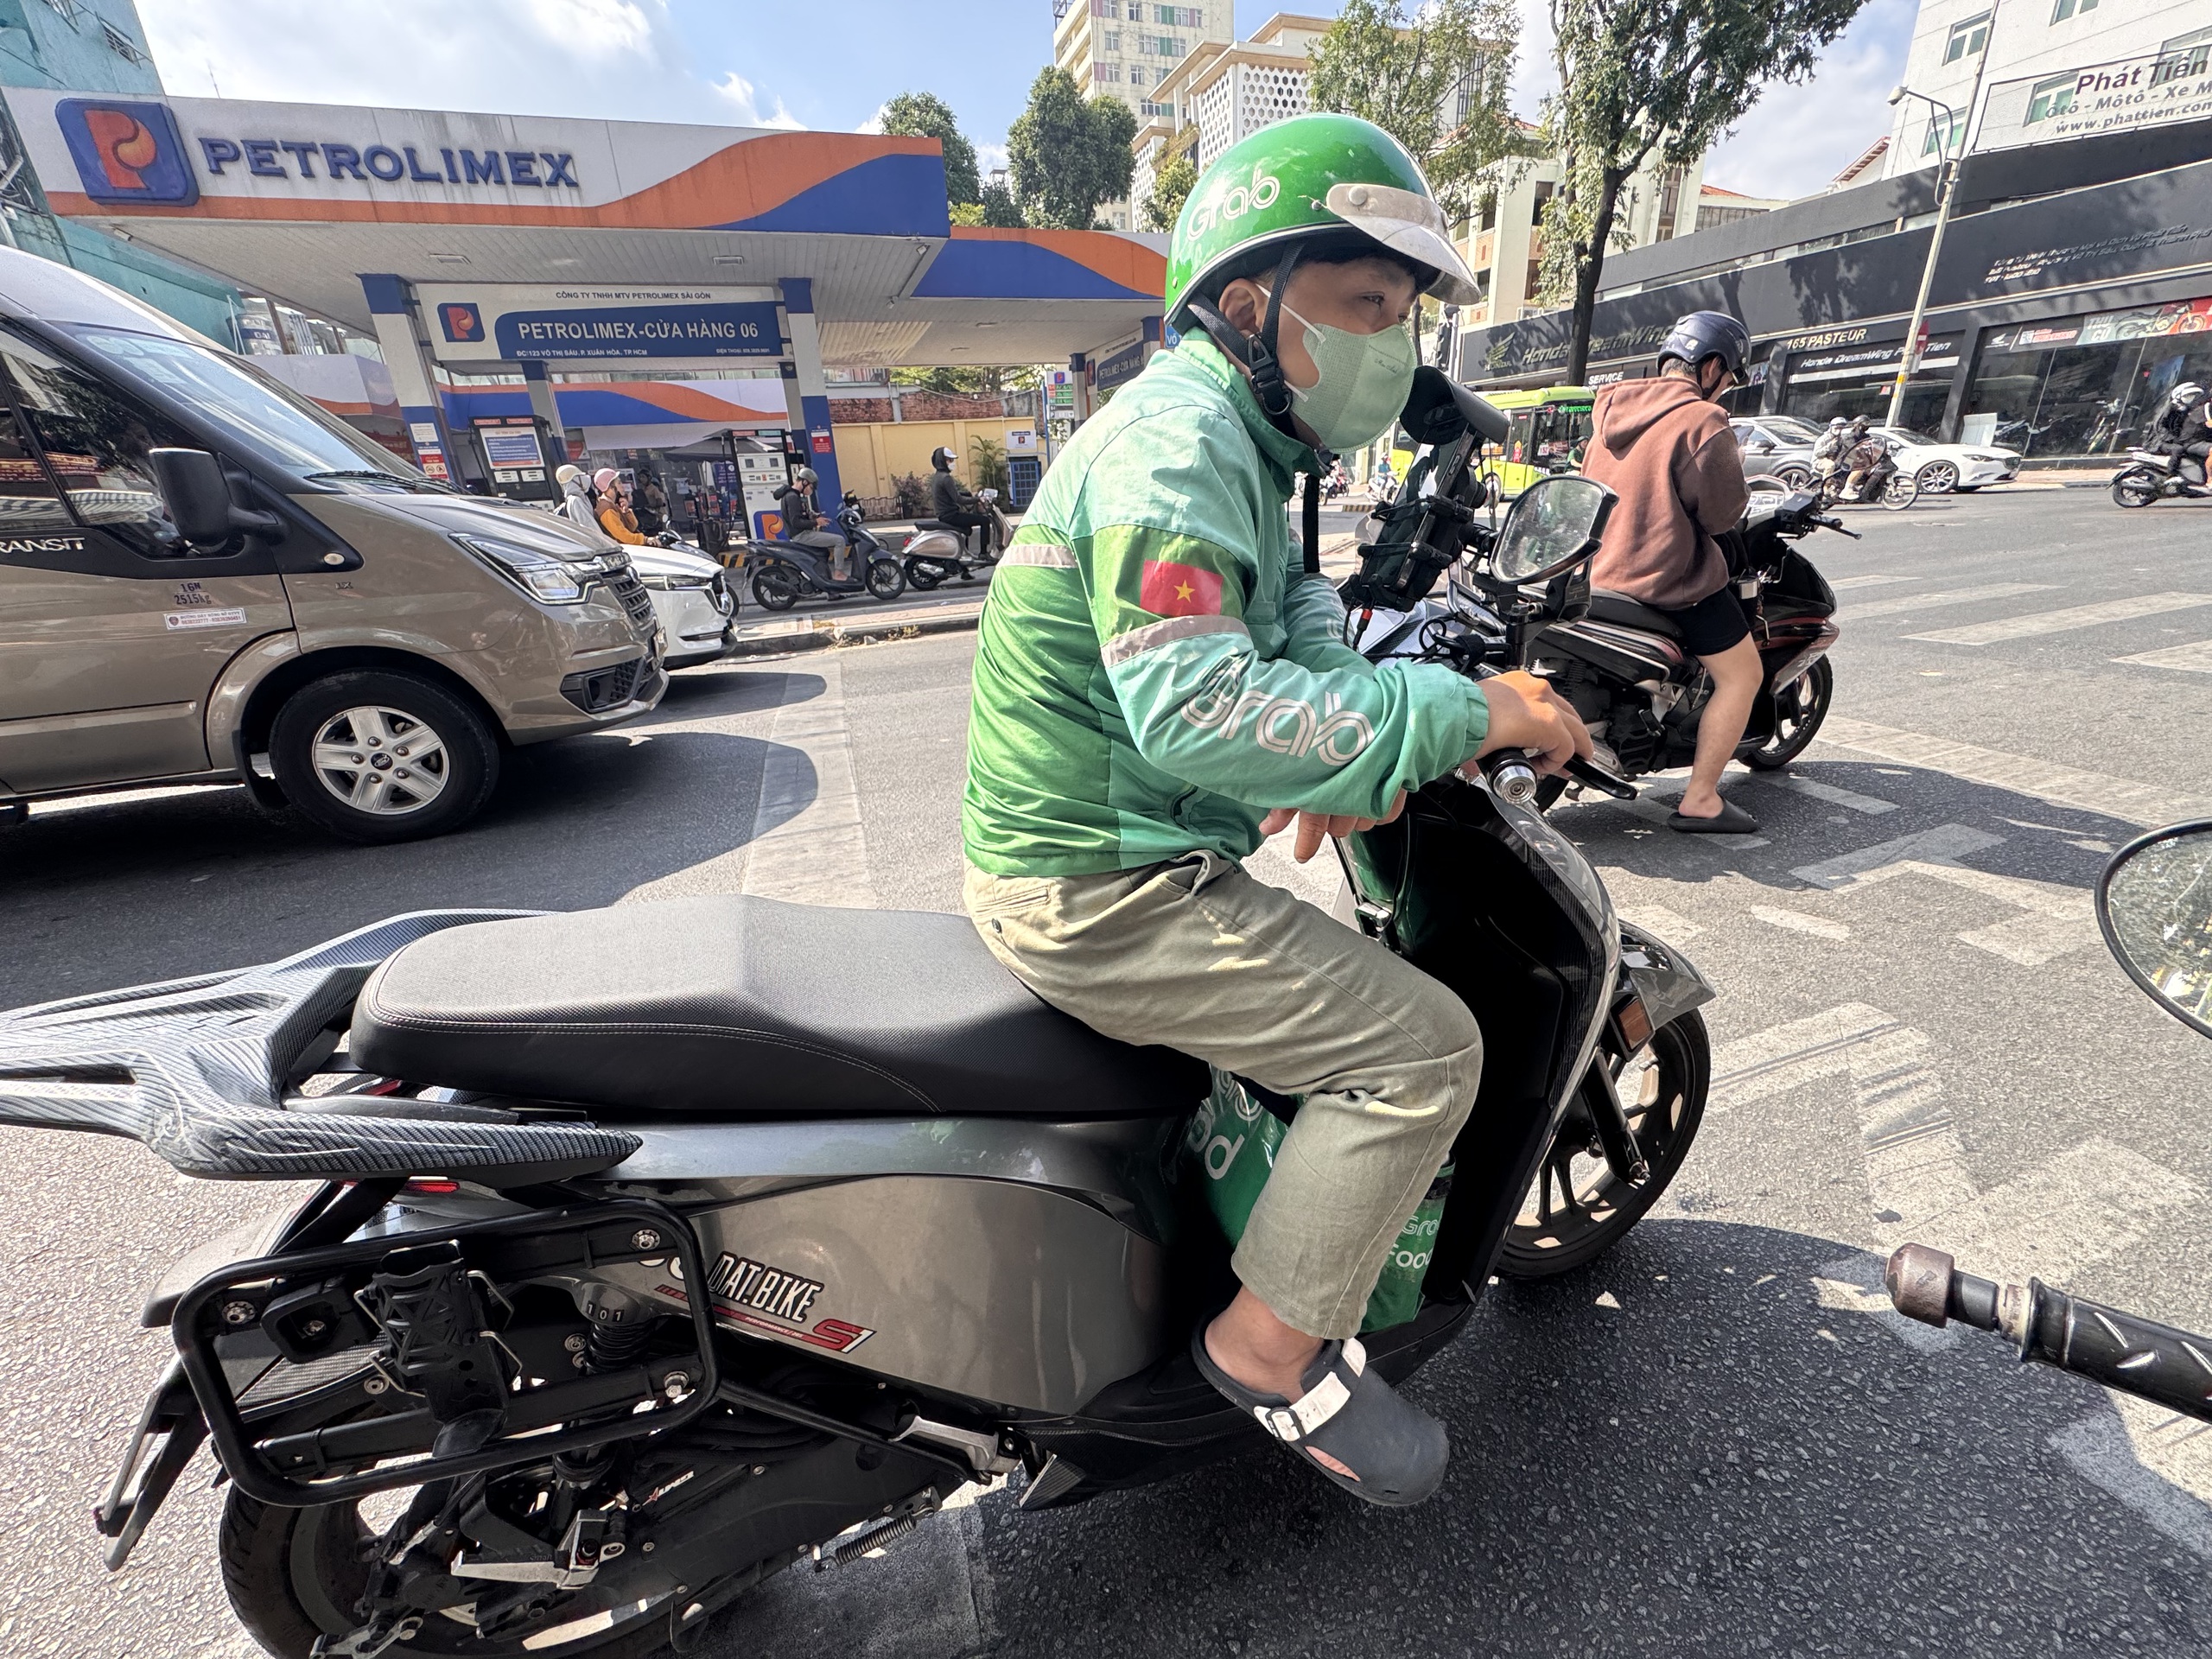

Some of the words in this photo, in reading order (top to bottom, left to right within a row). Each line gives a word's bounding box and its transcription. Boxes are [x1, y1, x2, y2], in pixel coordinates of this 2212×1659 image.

[2075, 64, 2142, 95] Phát
[2149, 49, 2209, 85] Tiến
[2095, 90, 2145, 110] Môtô
[2164, 86, 2189, 99] Xe
[198, 136, 579, 188] PETROLIMEX
[1187, 168, 1281, 242] Grab
[556, 290, 579, 299] CÔNG
[681, 290, 693, 299] SÀI
[518, 318, 684, 340] PETROLIMEX-CỬA
[687, 318, 735, 339] HÀNG
[741, 322, 759, 338] 06
[2087, 315, 2114, 330] THU
[1166, 333, 1177, 345] VÕ
[1522, 342, 1572, 366] Honda
[1587, 325, 1675, 356] reamWing
[1786, 338, 1806, 350] 165
[1807, 328, 1867, 347] PASTEUR
[1800, 355, 1832, 368] Honda
[1834, 347, 1894, 364] DreamWing
[1923, 341, 1952, 353] Tien
[1588, 371, 1624, 385] SERVICE
[174, 594, 213, 606] 2515kg
[1180, 656, 1376, 766] Grab
[1402, 1215, 1440, 1236] Gra
[708, 1253, 822, 1323] DAT.BIKE
